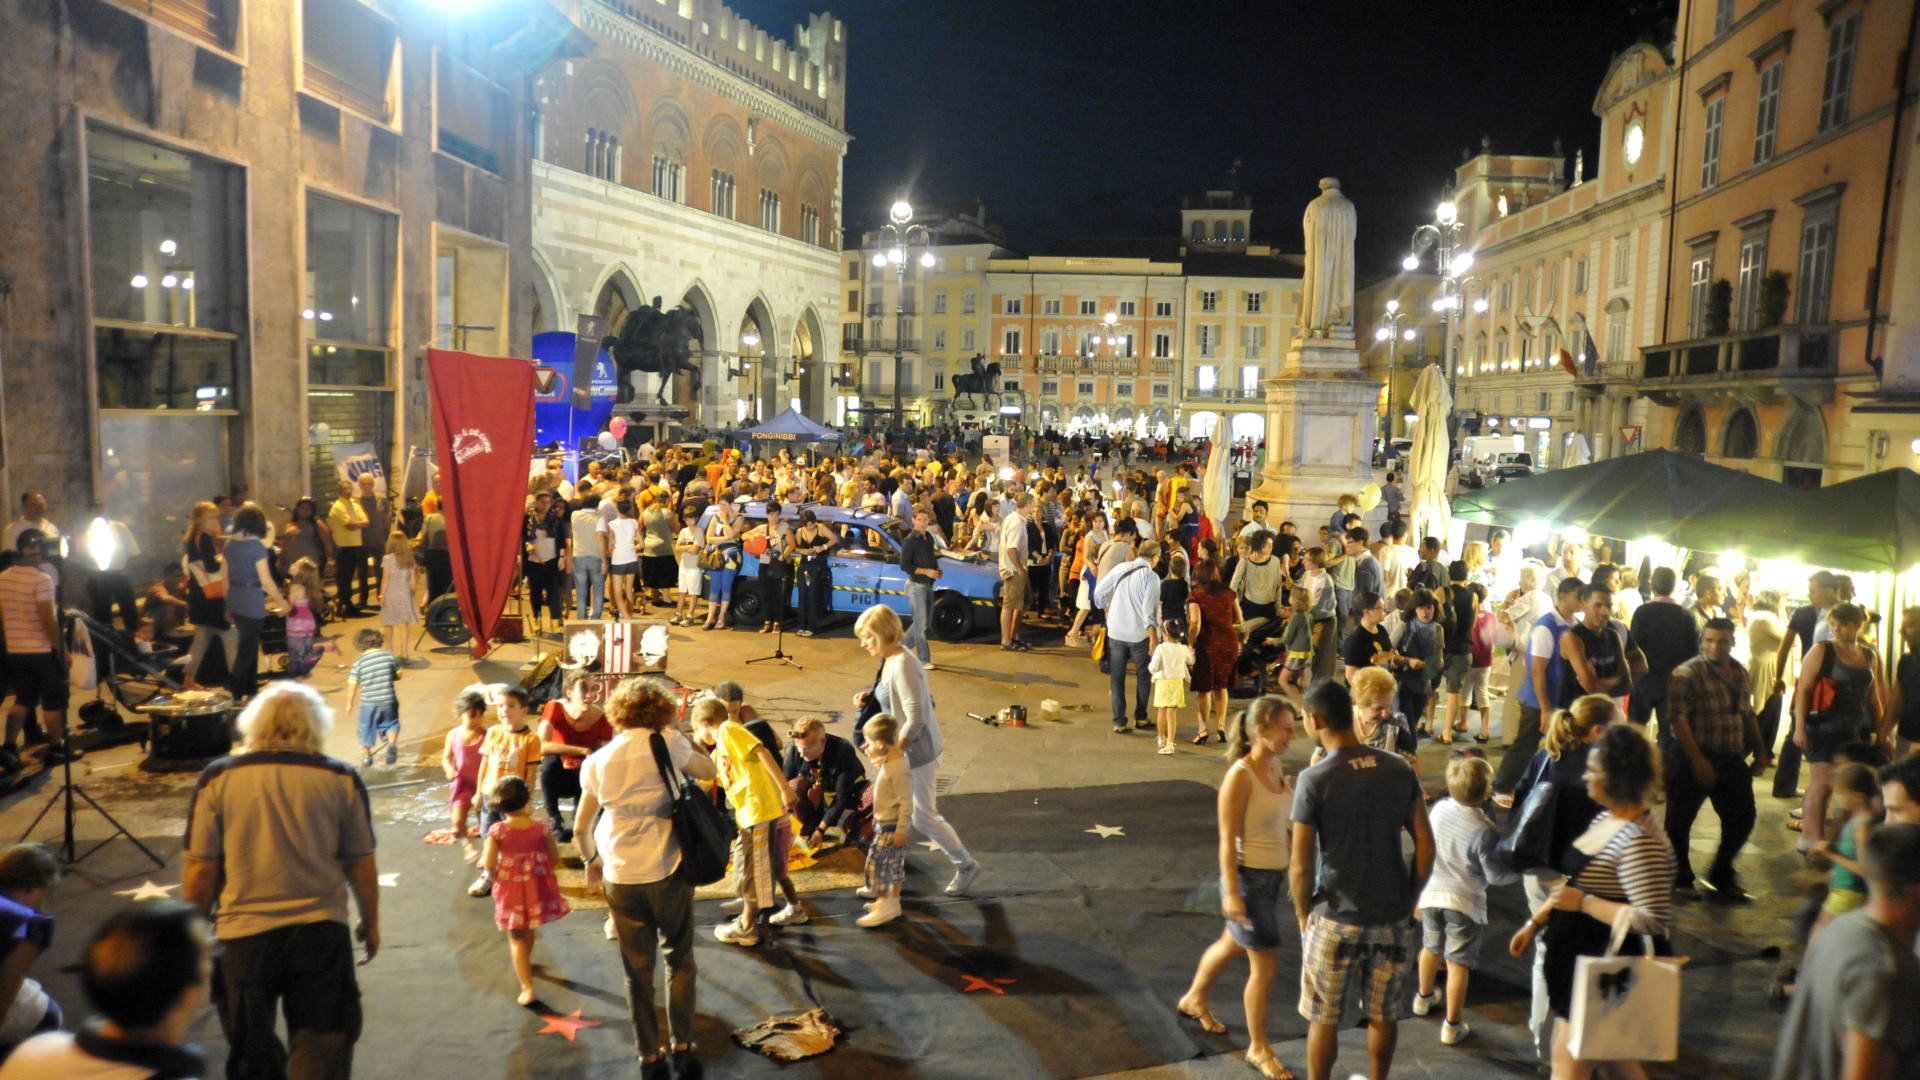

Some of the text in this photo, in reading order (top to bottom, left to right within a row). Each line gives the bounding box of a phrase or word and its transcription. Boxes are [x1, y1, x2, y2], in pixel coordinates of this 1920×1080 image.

[751, 432, 796, 440] PONGINIBBI
[851, 593, 872, 605] PIC
[1347, 755, 1378, 770] THE
